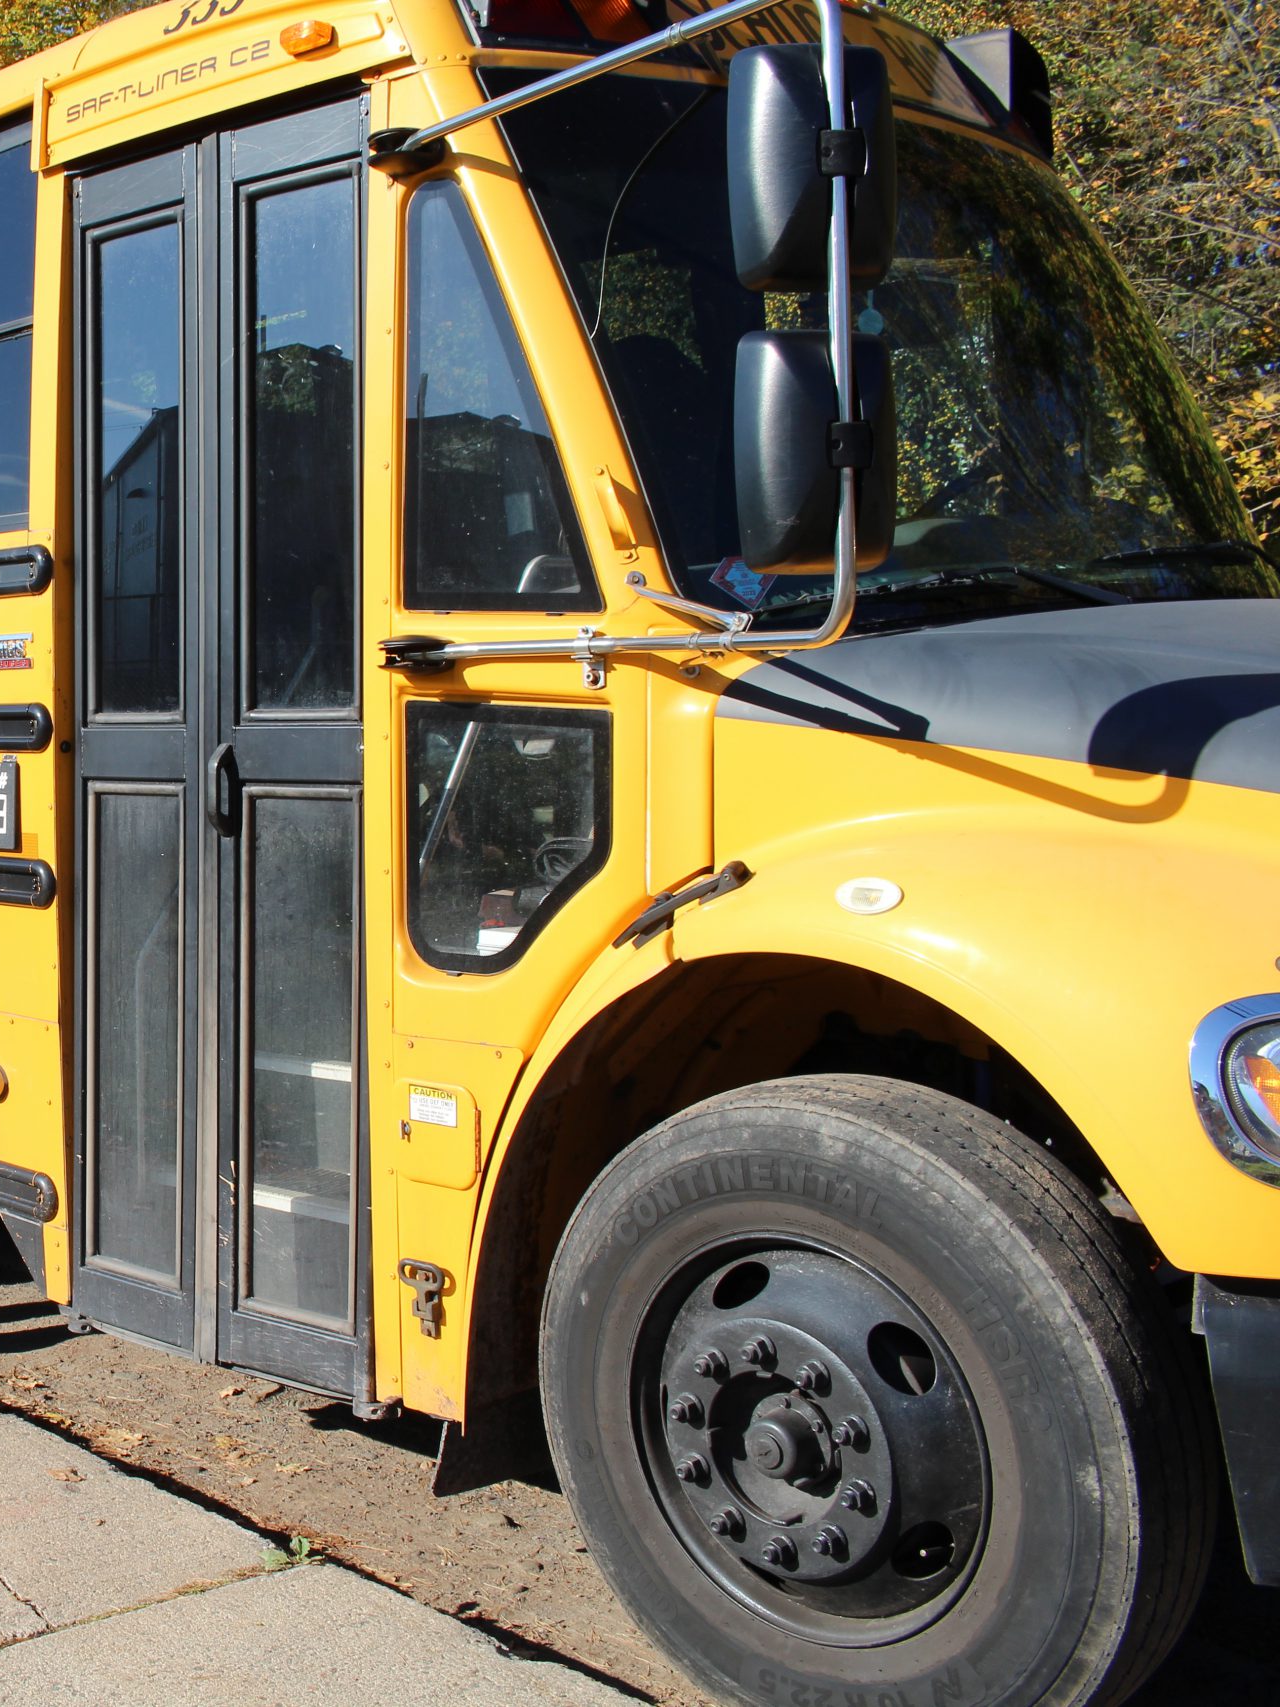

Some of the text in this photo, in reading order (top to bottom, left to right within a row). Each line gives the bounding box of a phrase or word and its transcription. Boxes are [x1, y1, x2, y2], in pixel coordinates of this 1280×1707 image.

[66, 40, 271, 124] SAF-T-LINER C2
[413, 1087, 453, 1101] CAUTION
[618, 1154, 884, 1246] CONTINENTAL
